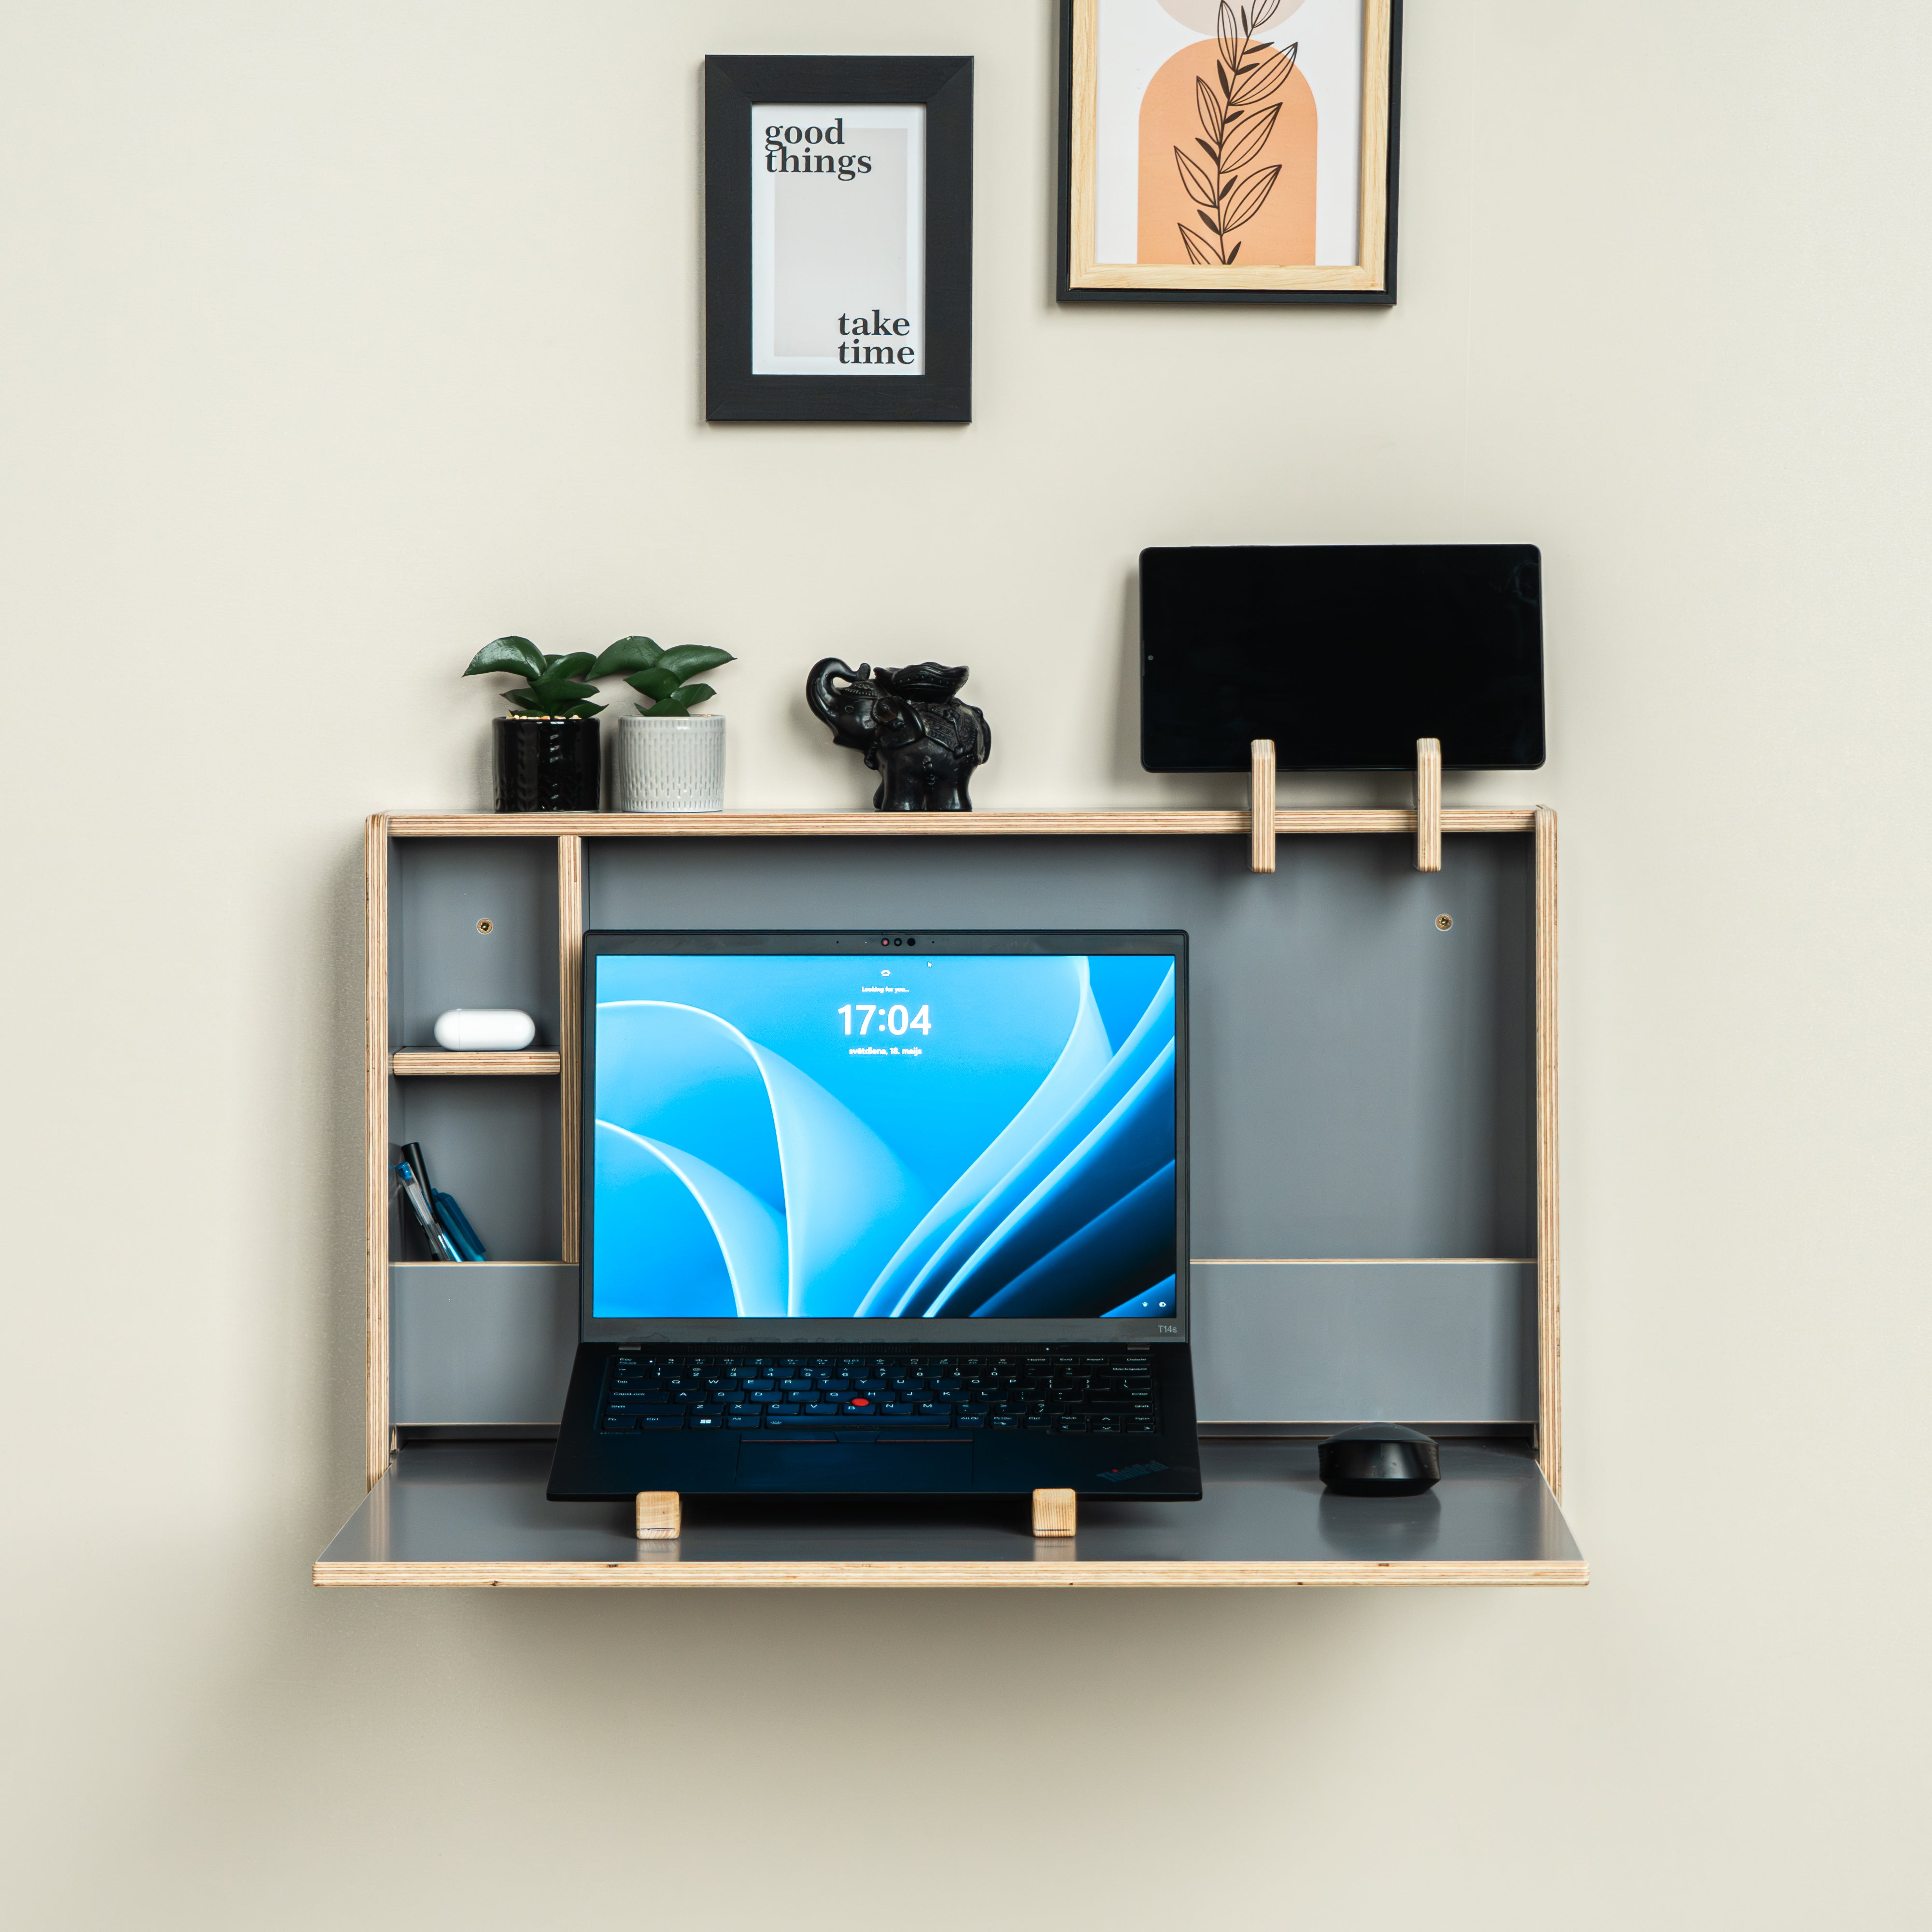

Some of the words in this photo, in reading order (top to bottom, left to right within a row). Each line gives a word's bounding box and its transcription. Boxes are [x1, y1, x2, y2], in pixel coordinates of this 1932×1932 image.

[765, 118, 844, 151] good
[765, 146, 872, 181] things
[838, 310, 909, 336] take
[838, 339, 915, 364] time
[838, 1004, 931, 1035] 17:04
[902, 1047, 922, 1056] maijs
